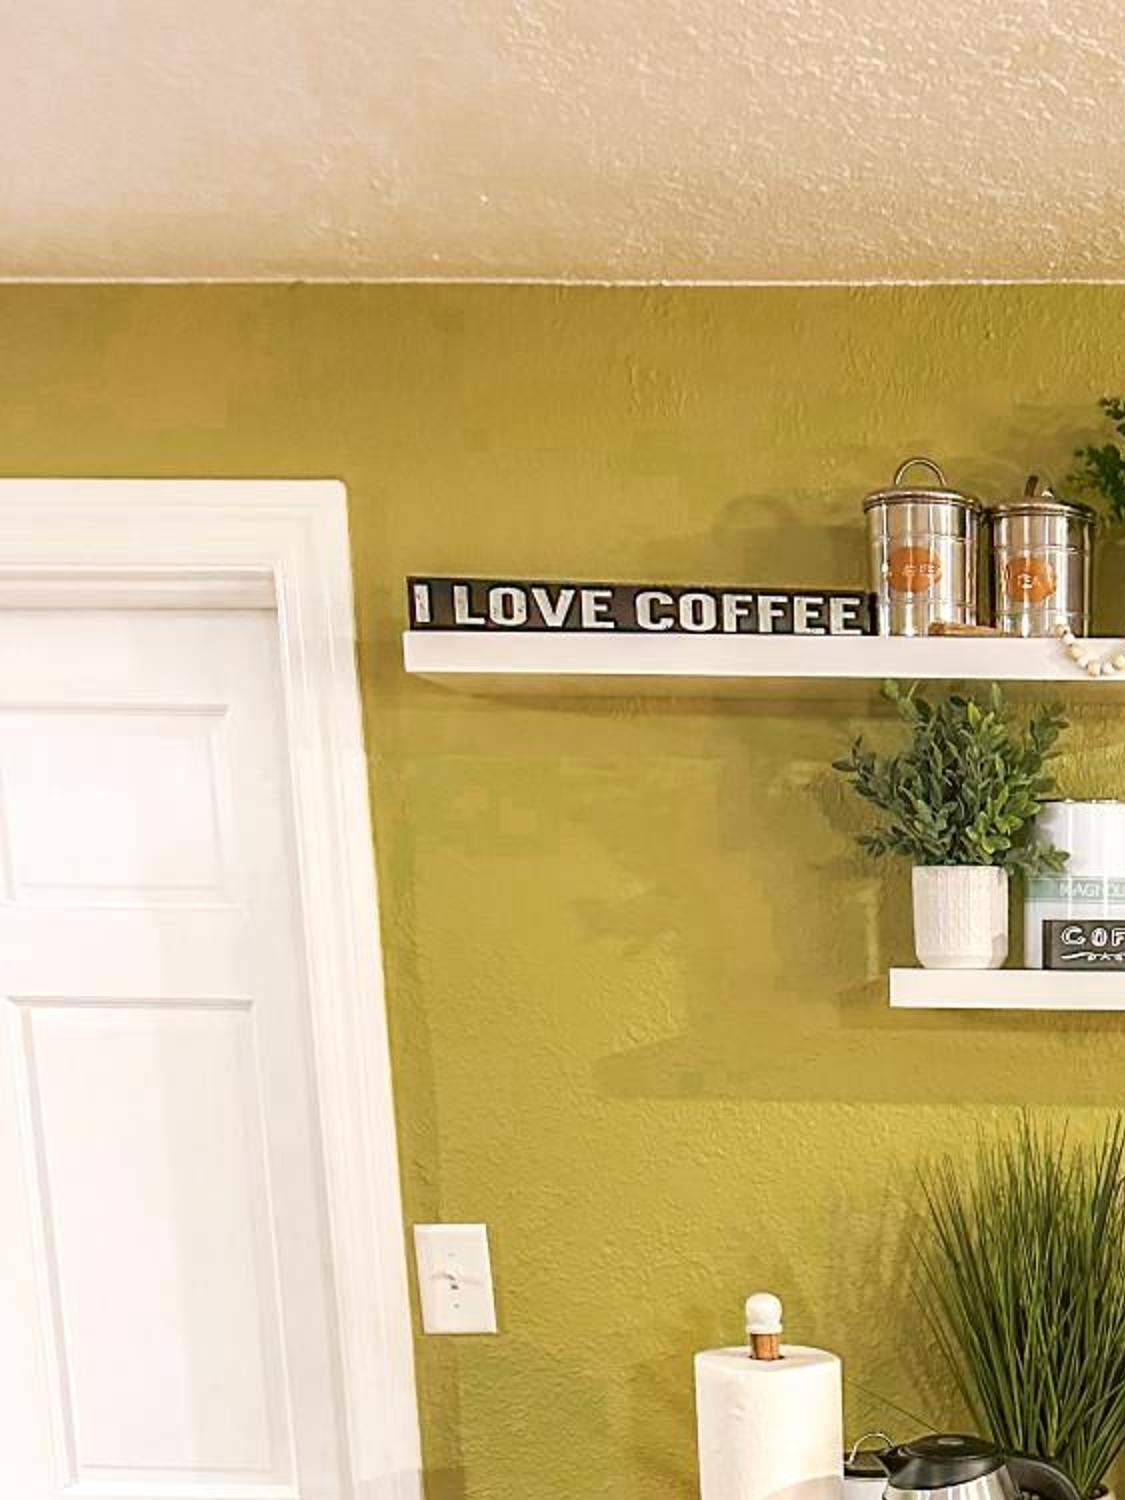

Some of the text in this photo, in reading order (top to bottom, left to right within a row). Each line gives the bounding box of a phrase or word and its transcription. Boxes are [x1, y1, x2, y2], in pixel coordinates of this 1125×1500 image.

[414, 584, 864, 636] I LOVE COFFEE
